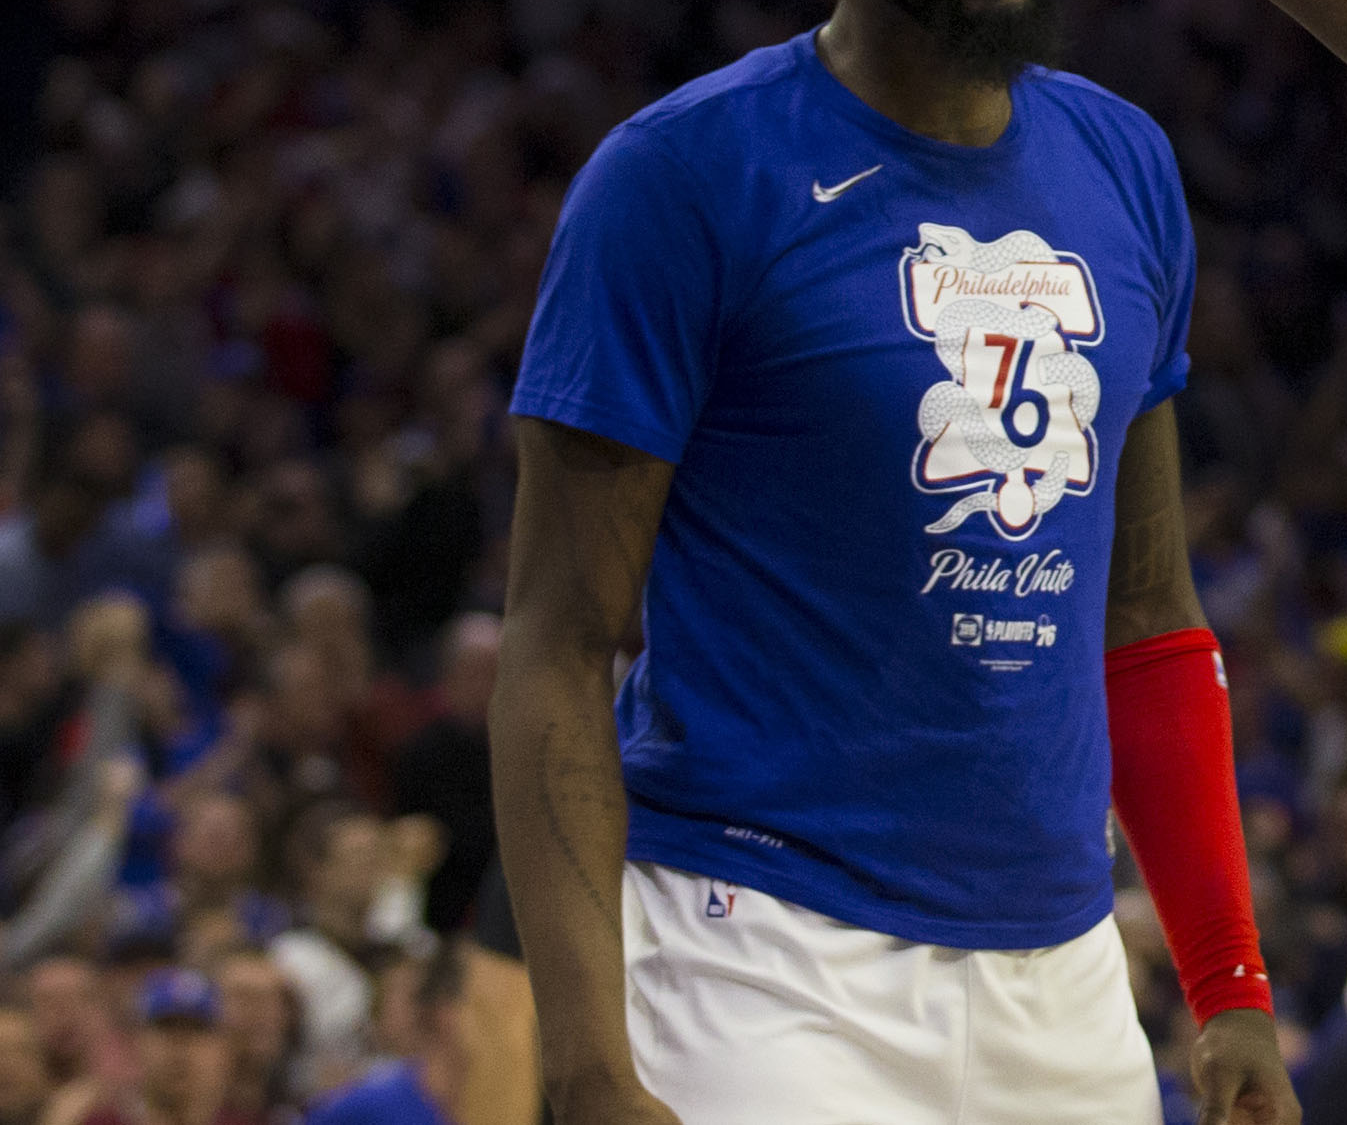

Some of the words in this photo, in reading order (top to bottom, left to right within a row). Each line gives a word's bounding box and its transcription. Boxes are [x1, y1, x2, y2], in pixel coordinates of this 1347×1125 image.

[933, 266, 1071, 304] Philadelphia
[984, 334, 1049, 448] 76
[921, 549, 1012, 594] Phila
[1015, 549, 1075, 597] Unite
